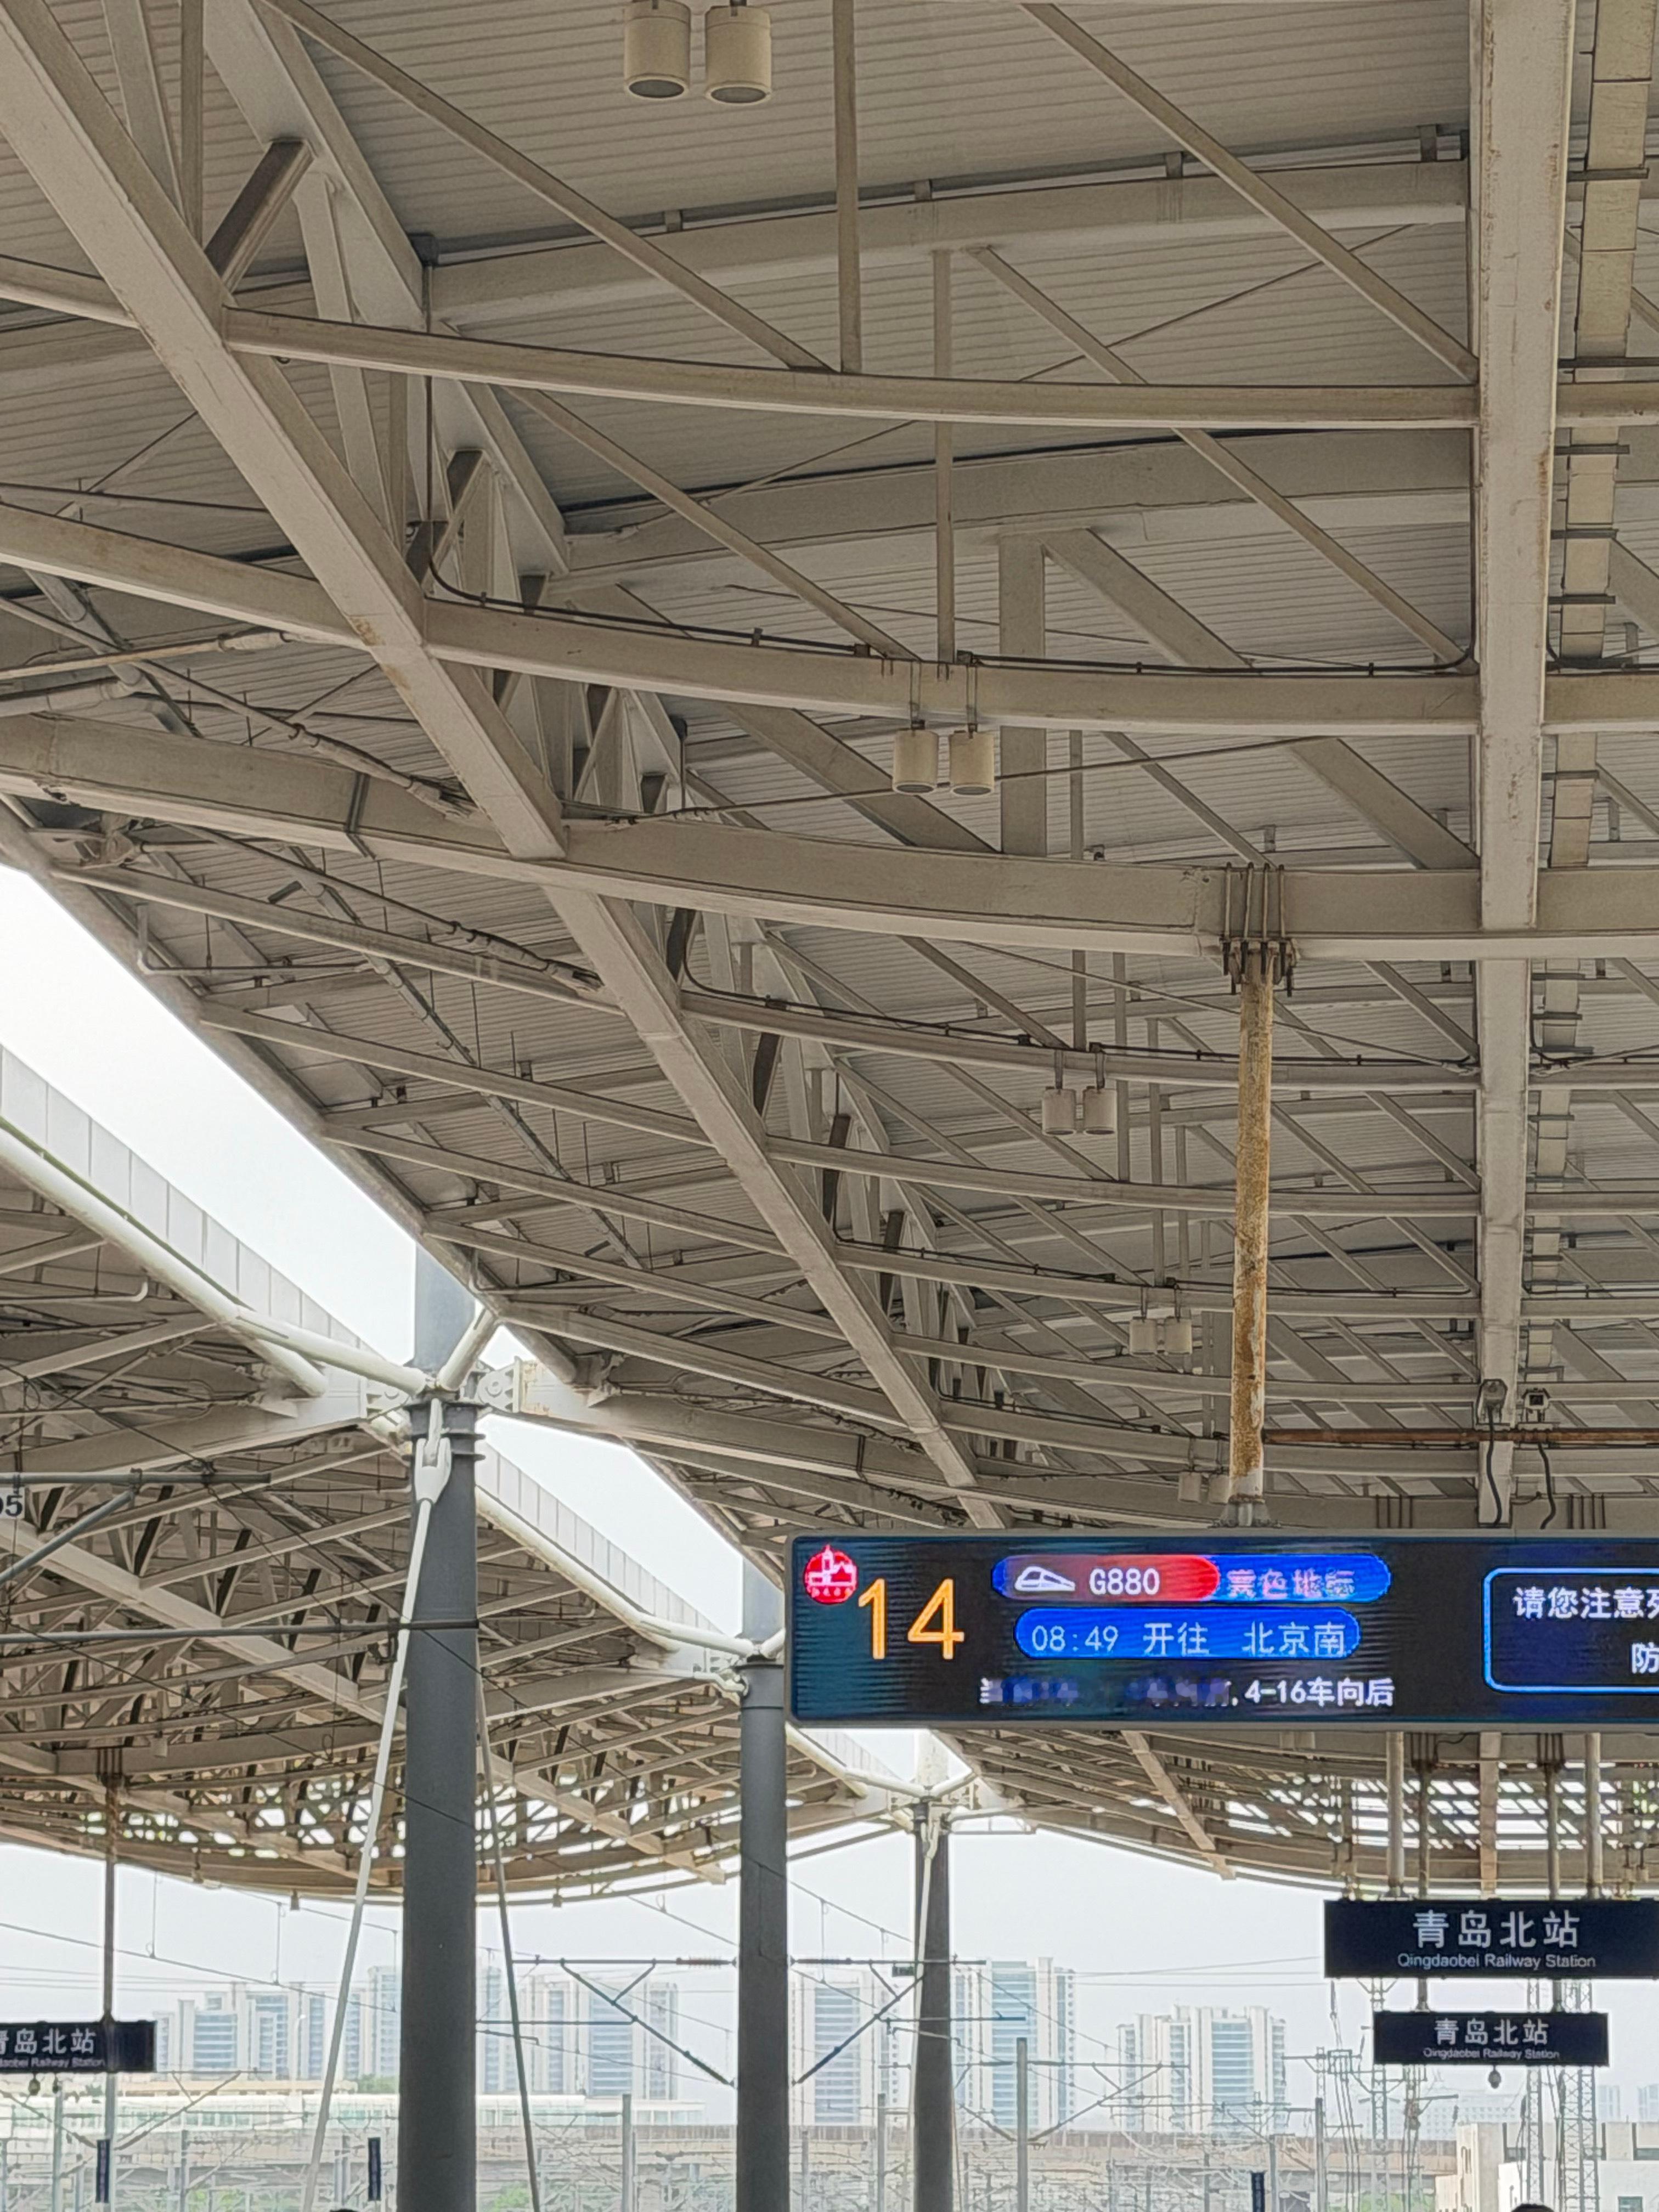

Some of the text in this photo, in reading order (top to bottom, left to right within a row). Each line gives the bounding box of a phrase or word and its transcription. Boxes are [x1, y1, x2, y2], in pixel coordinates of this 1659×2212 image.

[0, 1494, 23, 1517] 5
[1090, 1568, 1160, 1595] G880
[858, 1578, 964, 1660] 14
[1031, 1621, 1345, 1656] 08:49 开往 北京南
[1413, 1910, 1580, 1949] 青岛北站
[1398, 1953, 1596, 1971] Qingdaobei Railway Station
[1434, 2018, 1549, 2045] 青岛北站
